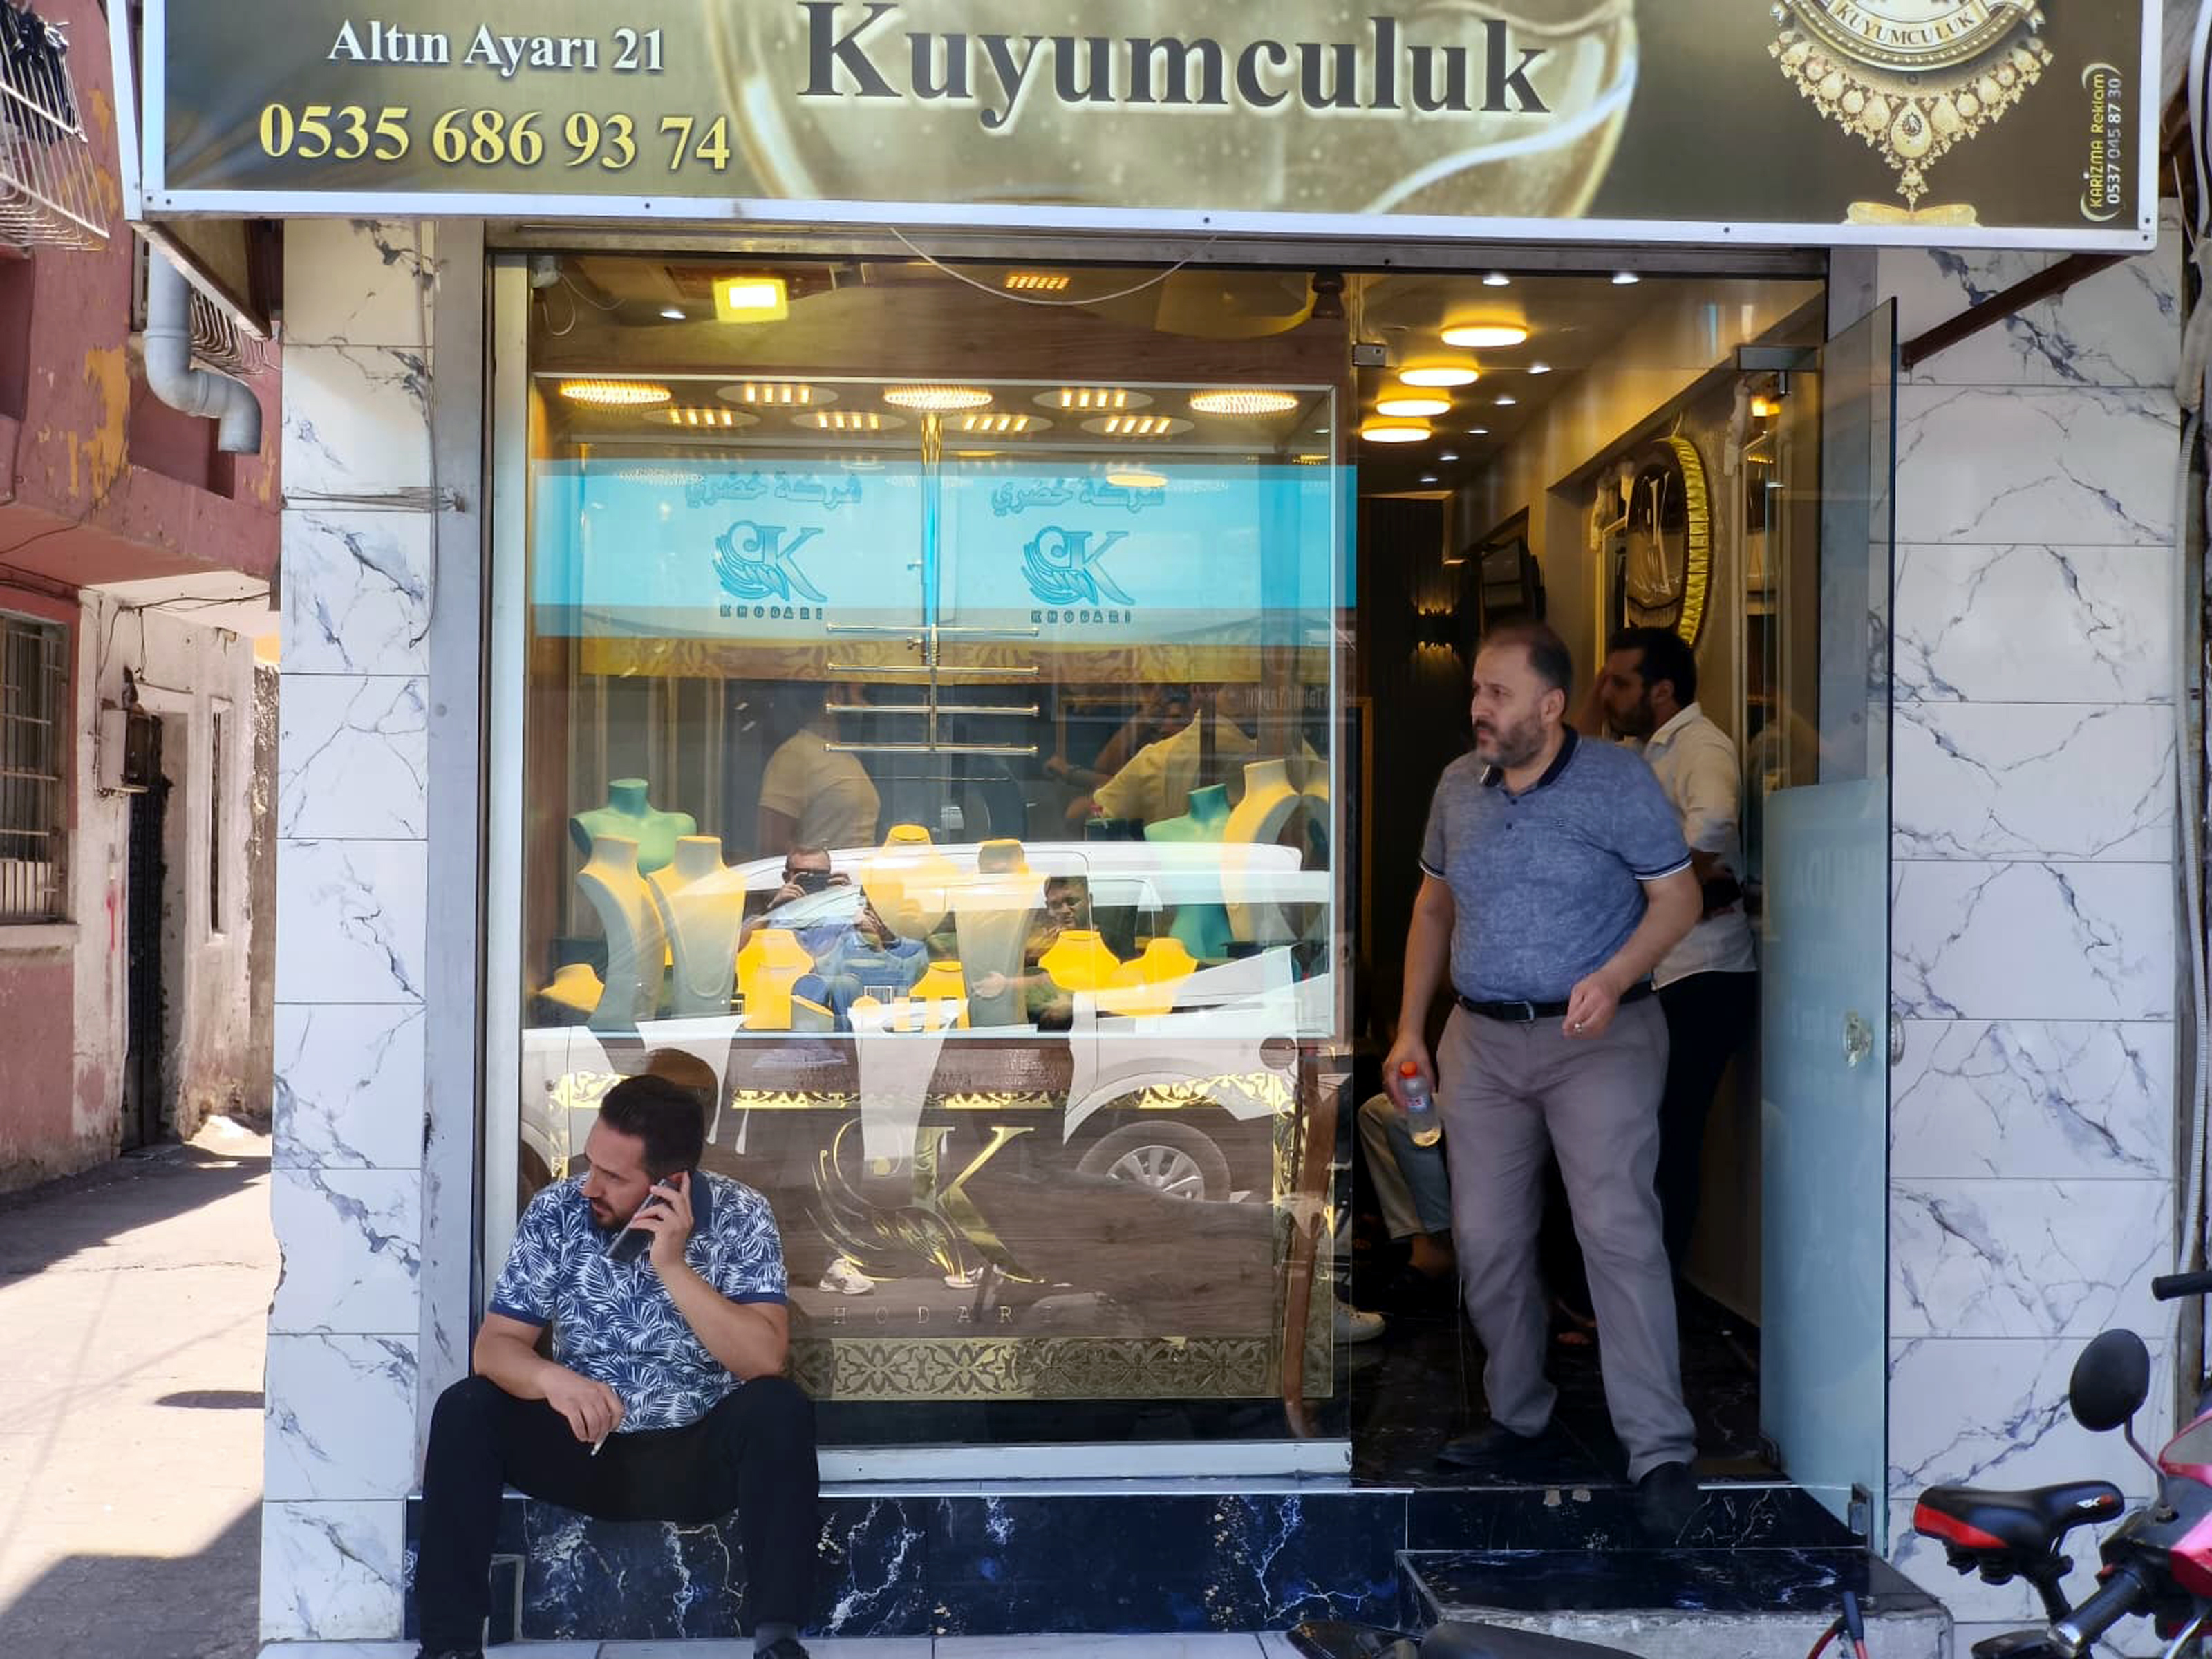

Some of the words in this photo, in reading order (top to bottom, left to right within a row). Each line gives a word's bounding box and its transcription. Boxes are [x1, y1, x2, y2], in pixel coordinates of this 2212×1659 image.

[1836, 3, 1974, 45] KUYUMCULUK
[327, 19, 450, 64] Altın
[464, 24, 598, 77] Ayarı
[612, 28, 664, 70] 21
[797, 1, 1550, 129] Kuyumculuk
[2090, 74, 2105, 133] Reklam
[2108, 77, 2122, 98] 30
[2108, 103, 2122, 124] 87
[260, 104, 410, 160] 0535
[433, 109, 543, 165] 686
[564, 113, 637, 168] 93
[659, 116, 731, 169] 74
[2107, 129, 2121, 158] 045
[2106, 163, 2121, 204] 0537
